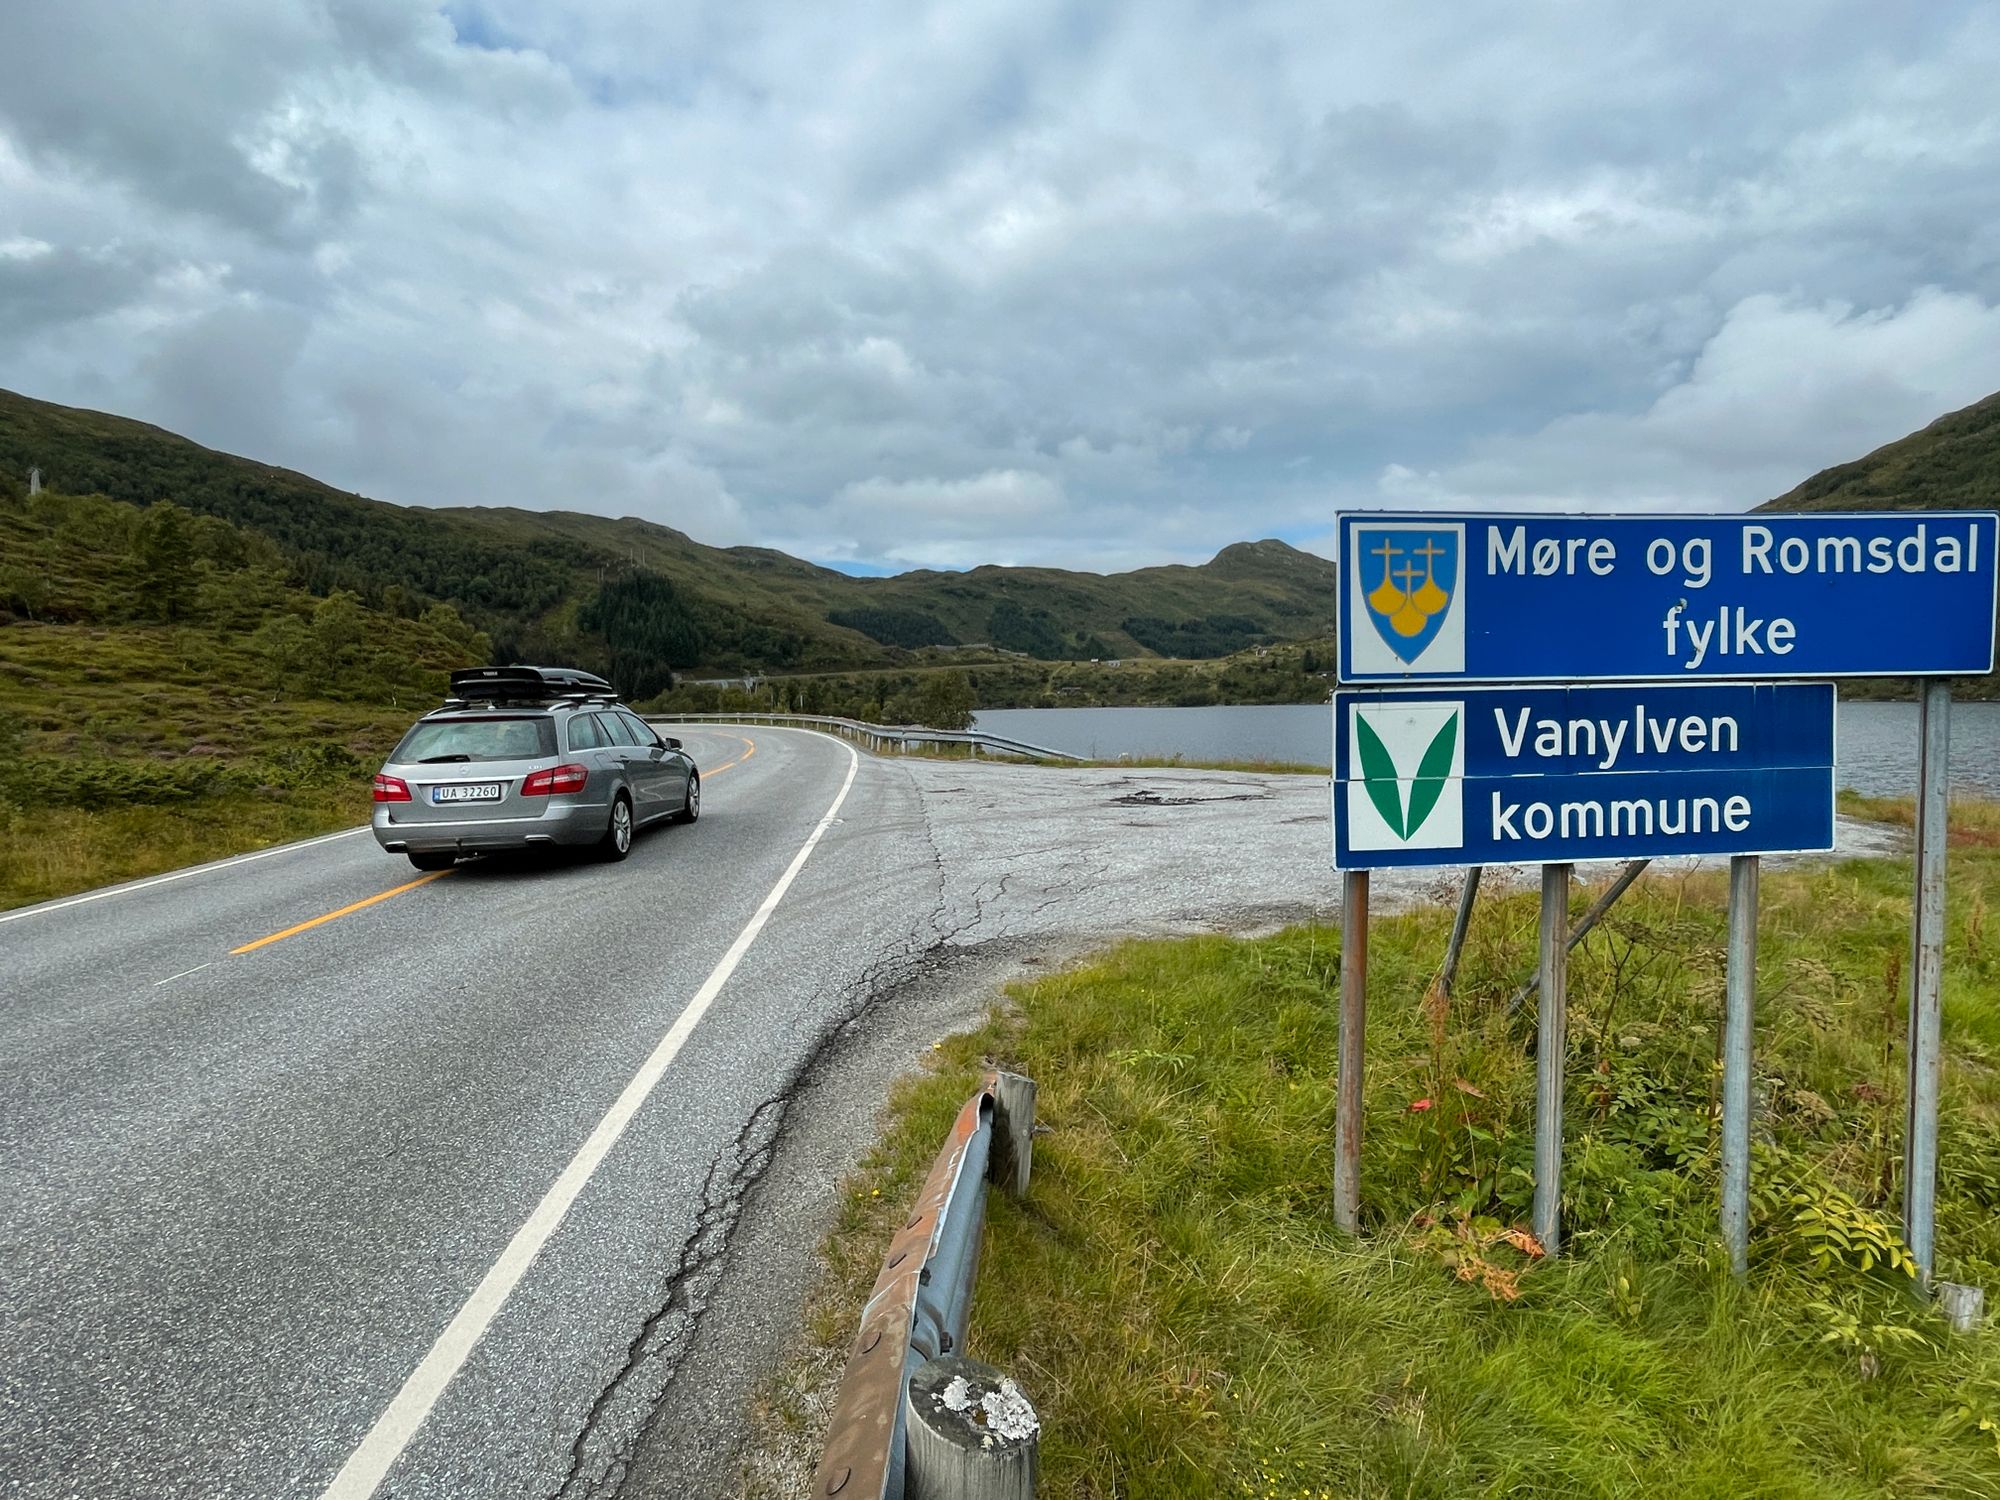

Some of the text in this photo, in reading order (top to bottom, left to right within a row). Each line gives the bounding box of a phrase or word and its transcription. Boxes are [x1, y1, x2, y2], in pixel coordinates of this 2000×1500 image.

[1487, 524, 1978, 588] Møre og Romsdal
[1663, 604, 1796, 669] fylke
[1494, 704, 1738, 770] Vanylven
[442, 786, 497, 799] UA 32260
[1492, 791, 1751, 841] kommune
